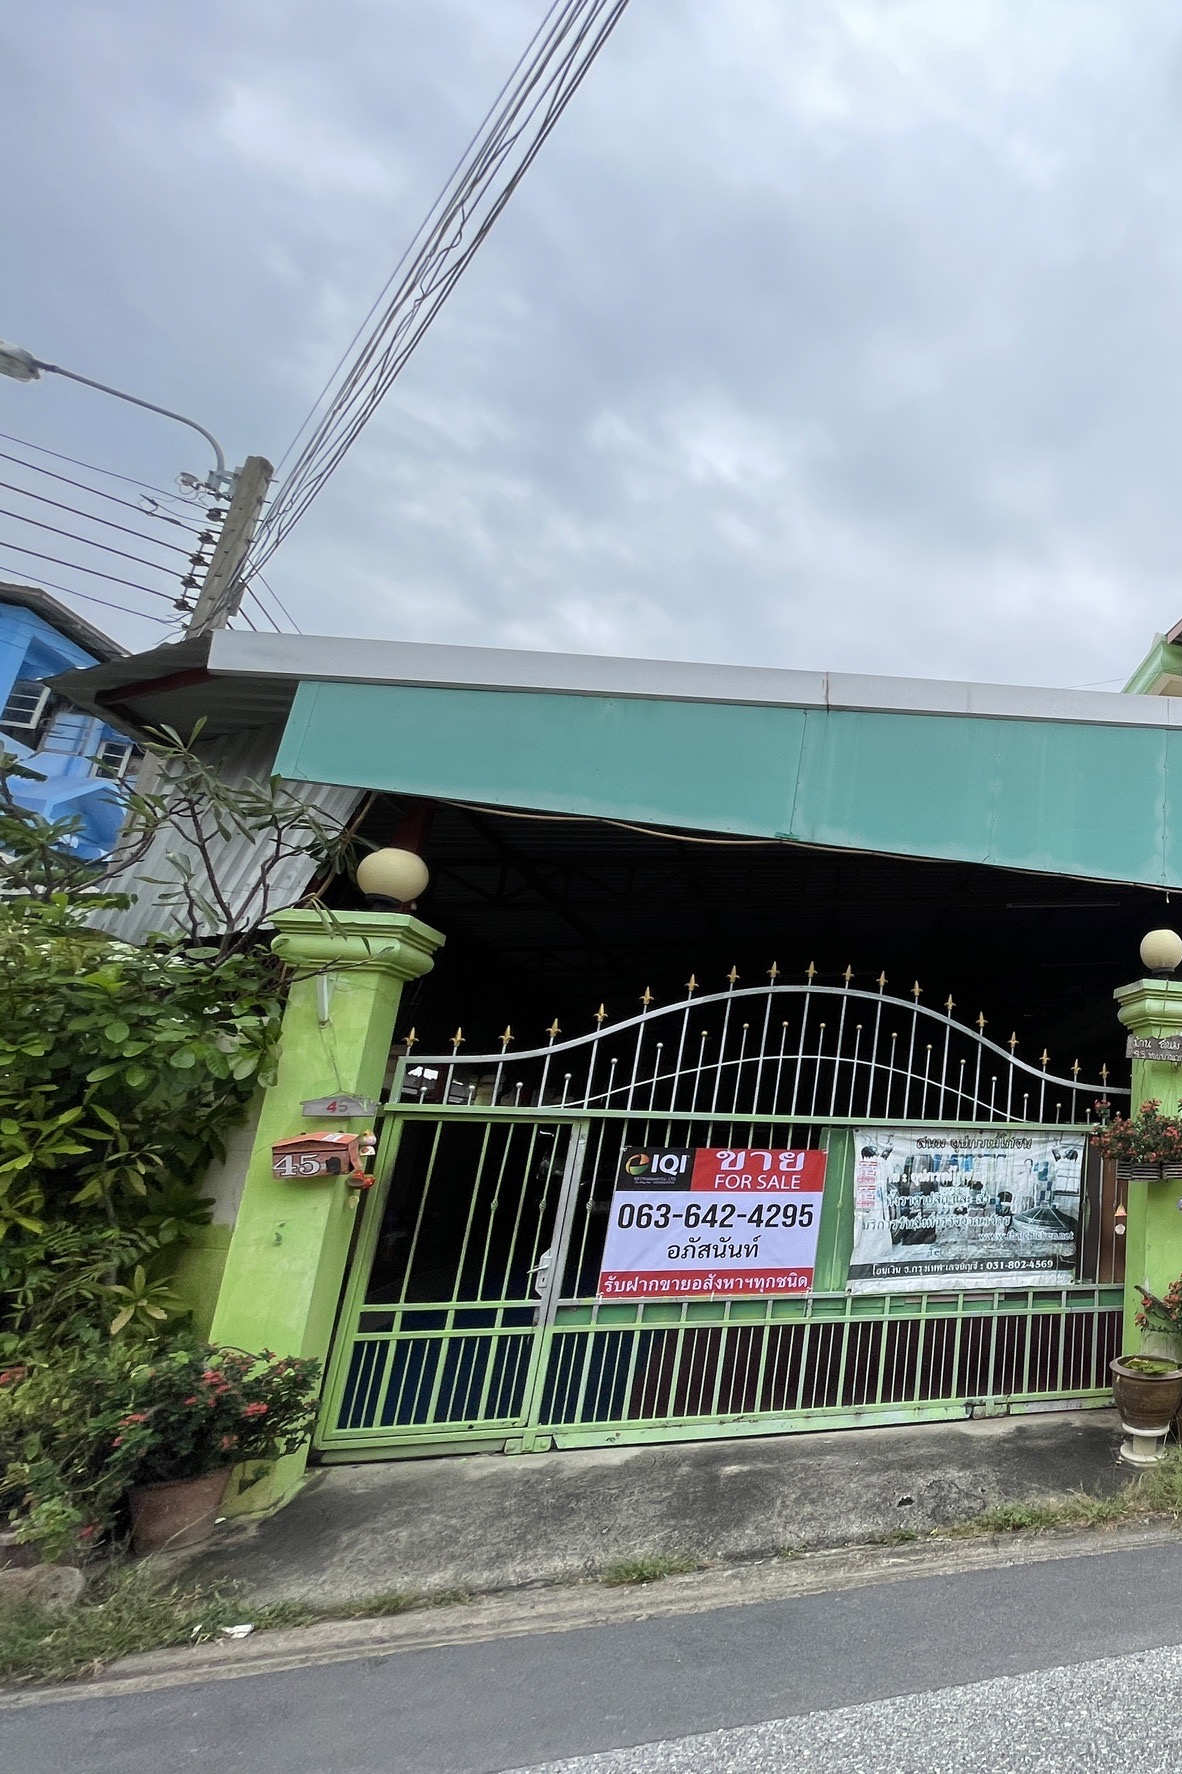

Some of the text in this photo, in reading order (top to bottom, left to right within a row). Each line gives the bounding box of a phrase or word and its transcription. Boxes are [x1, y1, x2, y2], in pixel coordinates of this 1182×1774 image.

[1133, 1036, 1152, 1049] บ้าน
[272, 1153, 321, 1177] 45
[651, 1154, 688, 1176] IQI
[715, 1150, 805, 1172] ขาย
[714, 1174, 802, 1190] FOR SALE
[617, 1203, 814, 1229] 063-642-4295
[667, 1235, 762, 1260] อภัสนันท์
[986, 1259, 1054, 1270] 031-802-4569
[604, 1272, 809, 1293] รับฝากขายอสังหาฯทุกชนิด
